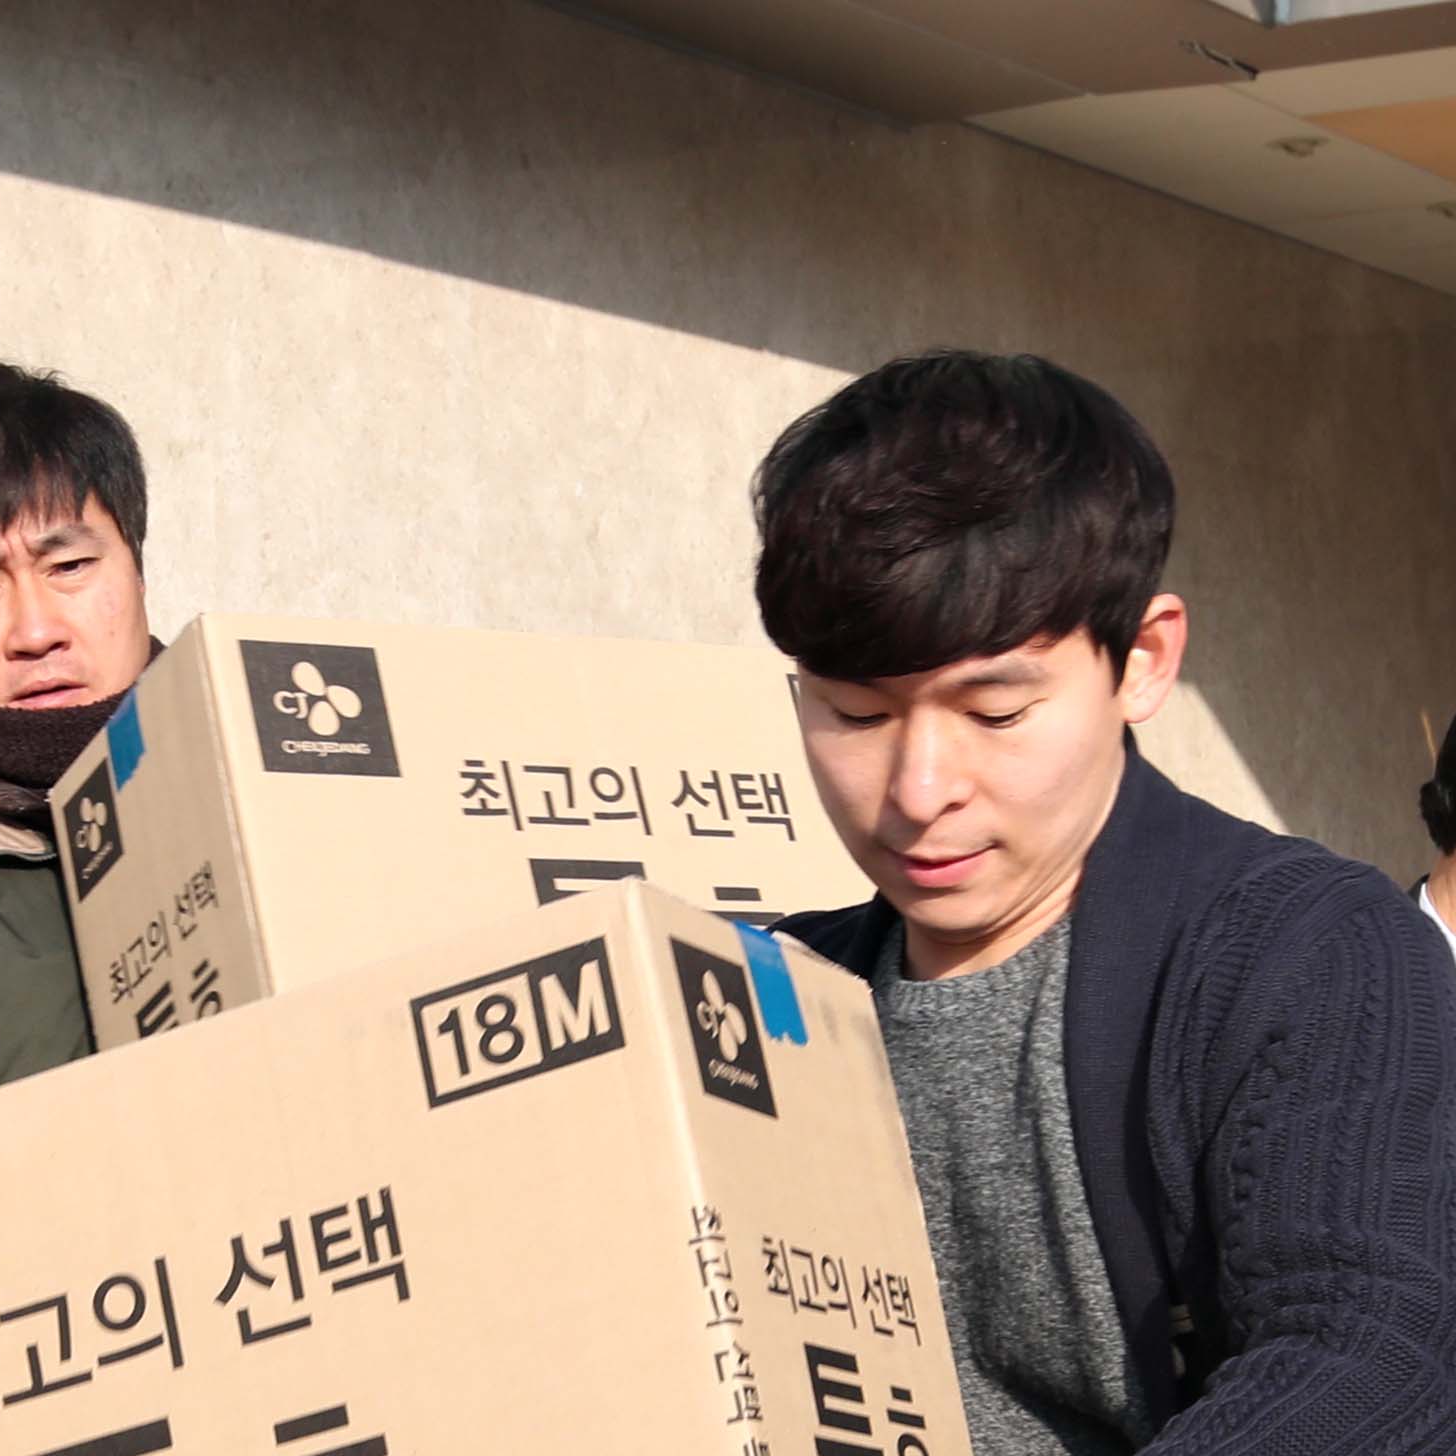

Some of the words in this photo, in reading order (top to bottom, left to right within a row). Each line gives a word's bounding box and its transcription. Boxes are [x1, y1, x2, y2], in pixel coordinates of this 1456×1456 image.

[459, 757, 653, 836] 최고의
[672, 770, 798, 842] 선택
[109, 909, 173, 1005] 최고의
[172, 860, 219, 941] 선택
[215, 1186, 412, 1347] 선택
[689, 1204, 744, 1329] 최고의
[760, 1234, 857, 1330] 최고의
[861, 1264, 922, 1347] 선택
[711, 1340, 764, 1426] 선택
